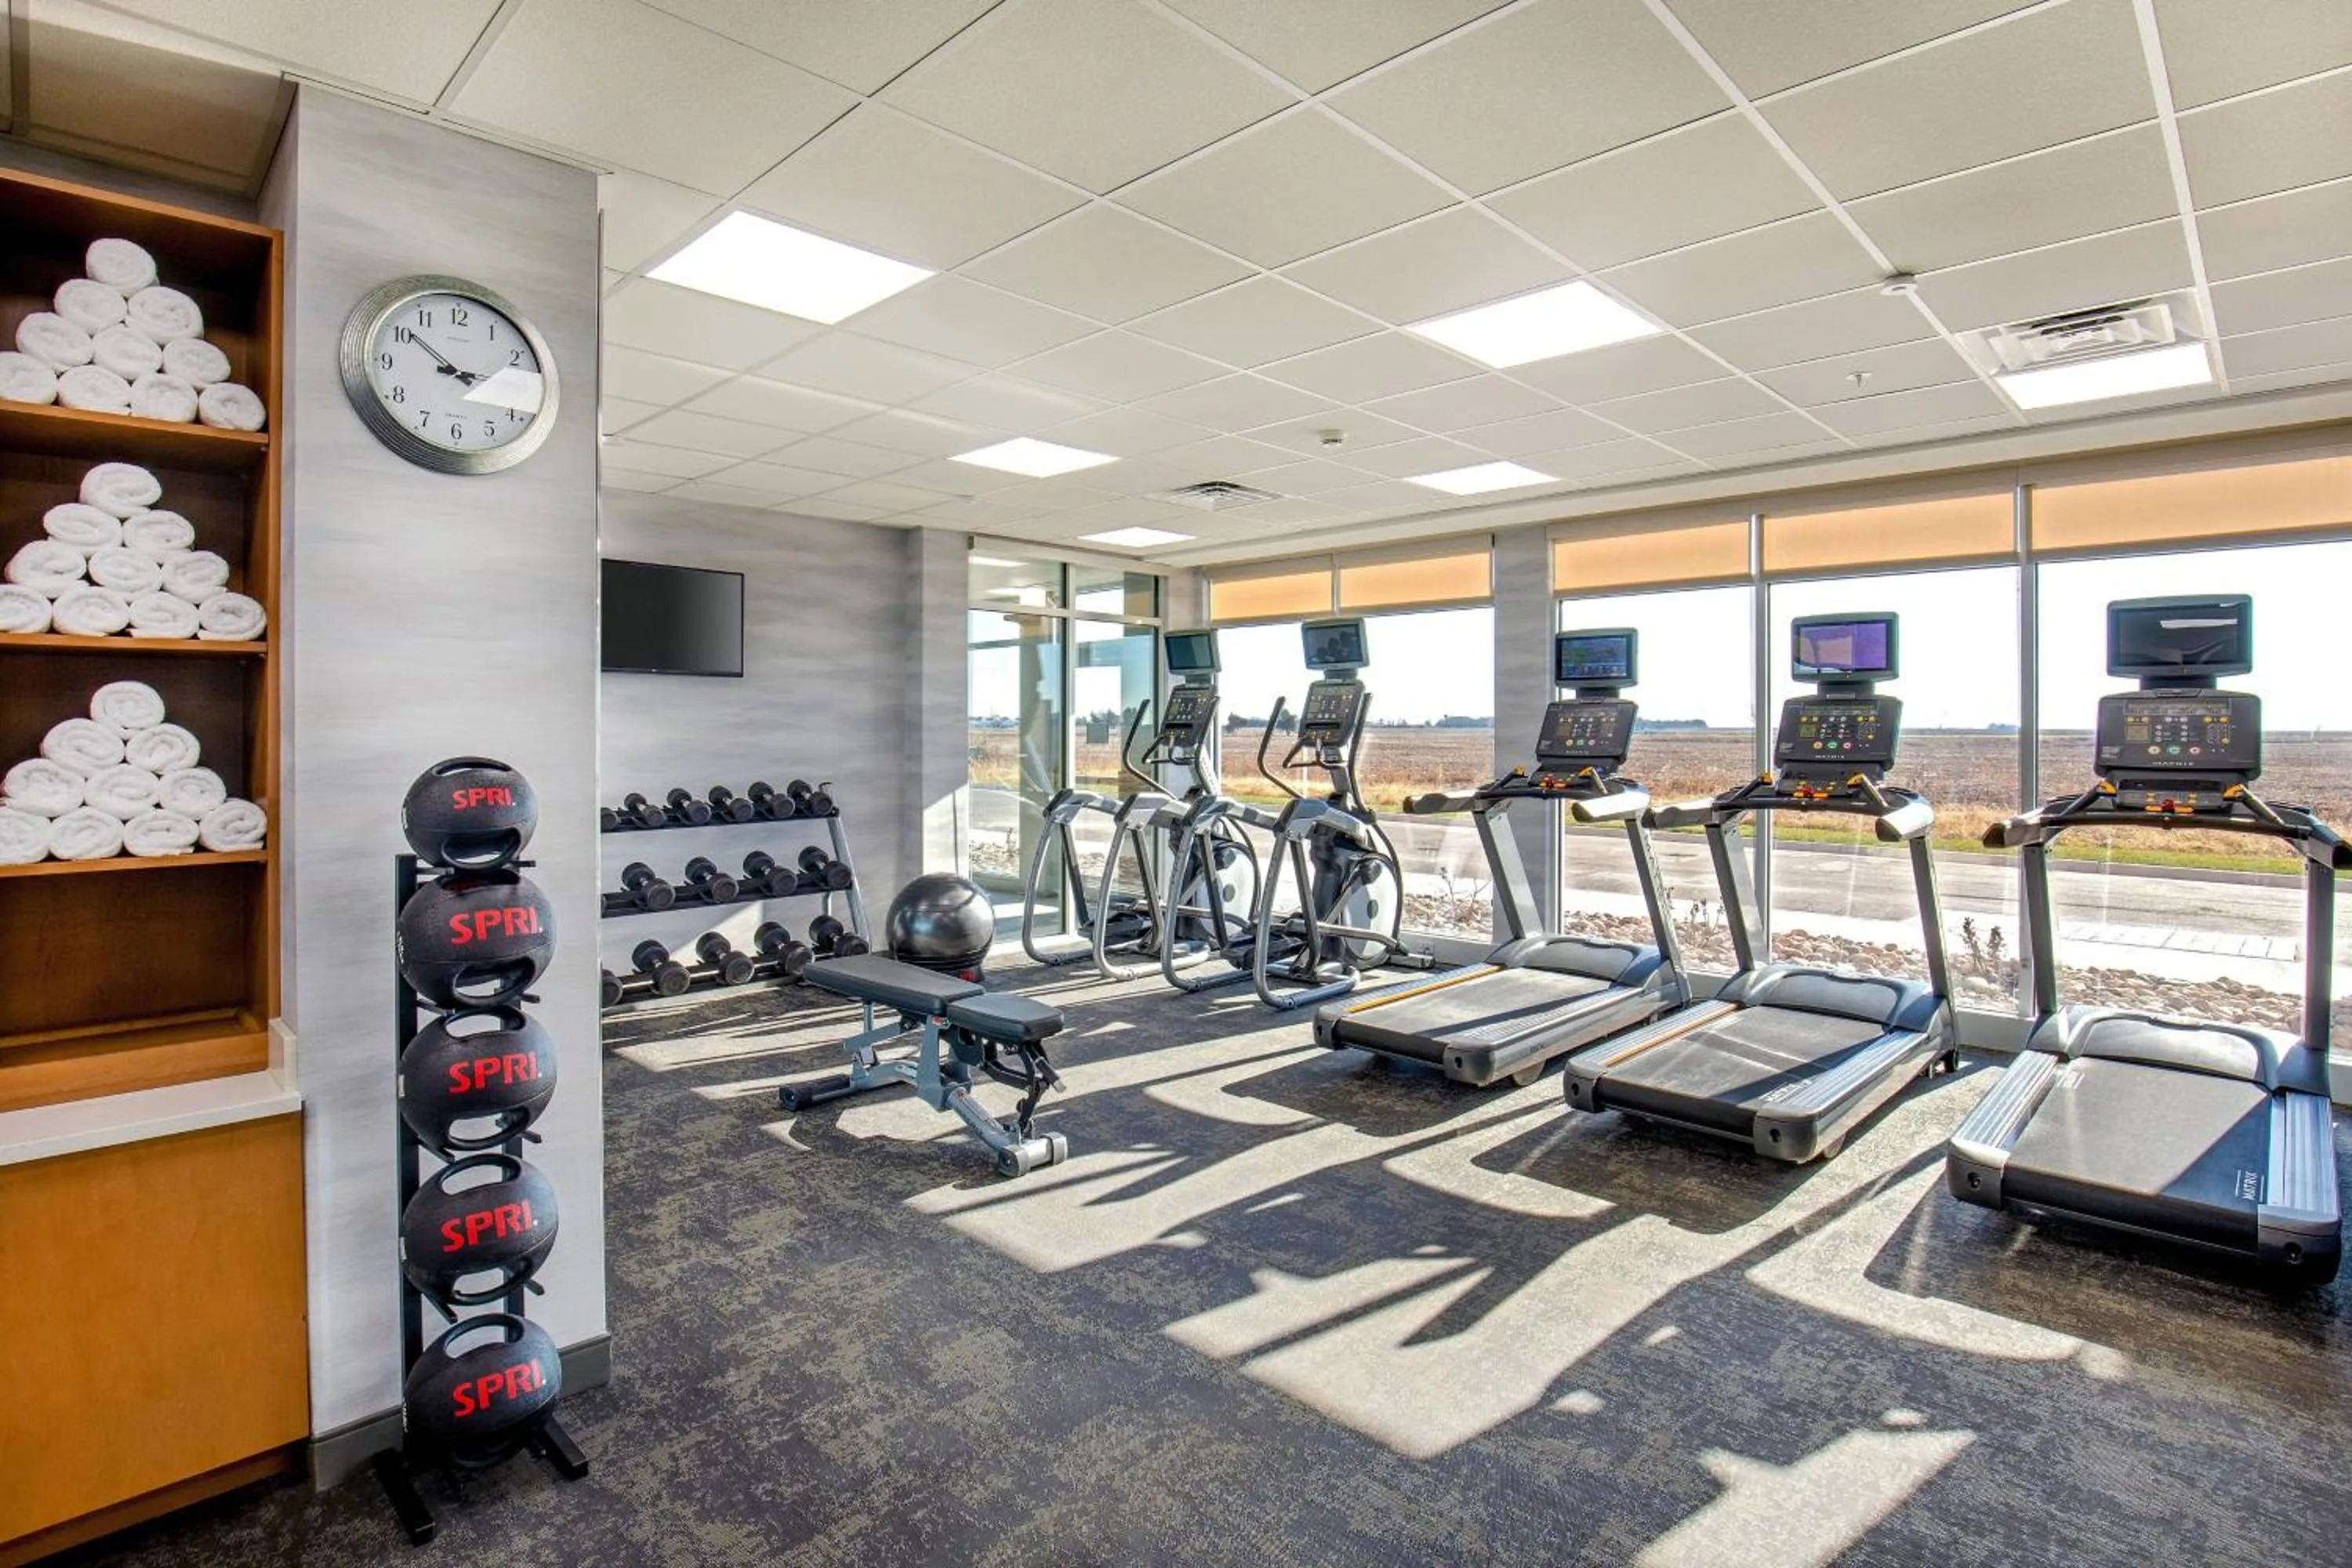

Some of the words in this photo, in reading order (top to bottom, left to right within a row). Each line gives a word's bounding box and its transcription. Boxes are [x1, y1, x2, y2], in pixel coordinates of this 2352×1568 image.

[418, 309, 431, 328] 11
[452, 308, 468, 327] 12
[394, 325, 412, 345] 10
[488, 324, 494, 342] 1
[381, 353, 393, 371] 9
[510, 350, 521, 367] 2
[393, 386, 405, 404] 8
[419, 410, 430, 428] 7
[484, 420, 495, 437] 5
[451, 423, 463, 441] 6
[452, 786, 512, 811] SPRI
[450, 906, 540, 946] SPRI
[448, 1052, 538, 1094] SPRI
[441, 1200, 533, 1253] SPRI
[452, 1359, 544, 1417] SPRI
